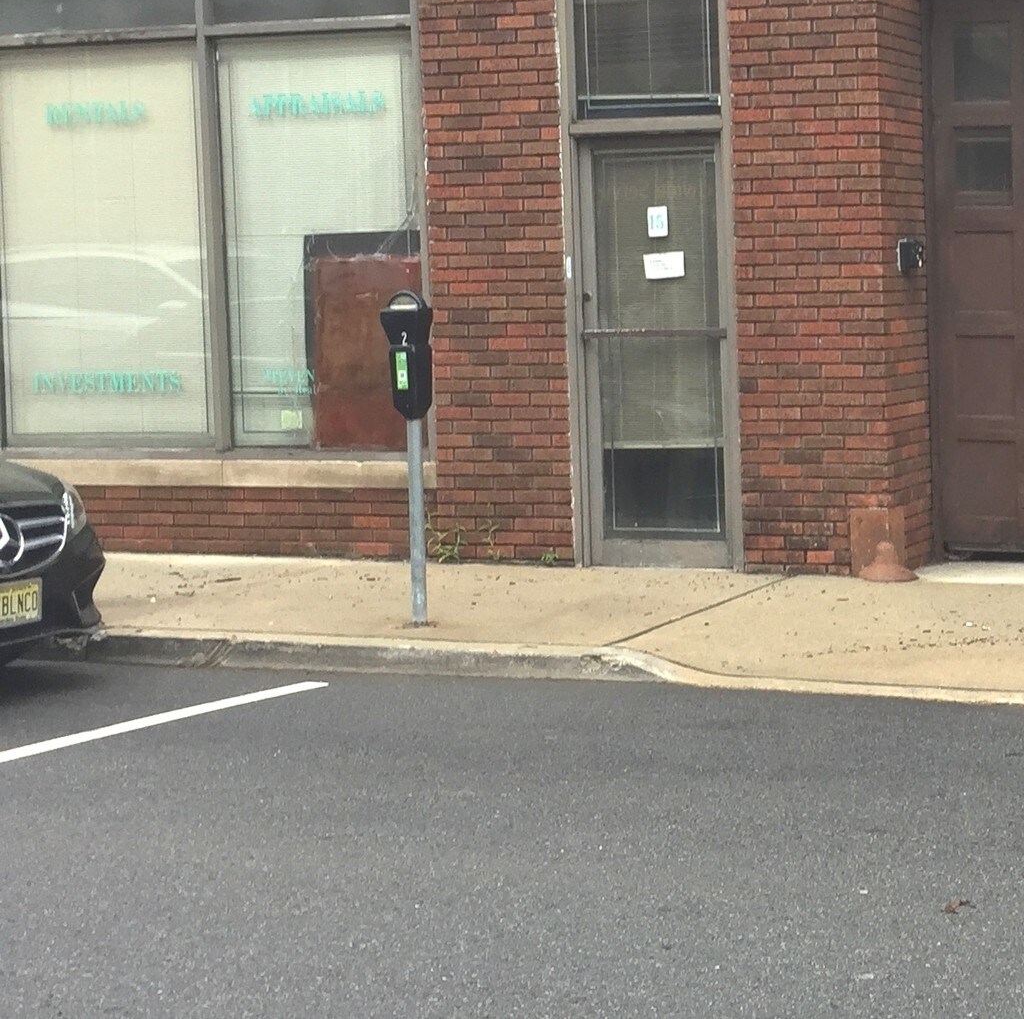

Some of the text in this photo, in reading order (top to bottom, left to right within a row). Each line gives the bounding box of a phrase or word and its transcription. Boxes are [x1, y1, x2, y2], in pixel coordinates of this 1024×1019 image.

[45, 99, 146, 125] RENTALS
[401, 331, 408, 346] 2
[31, 369, 183, 394] INVESTMENTS
